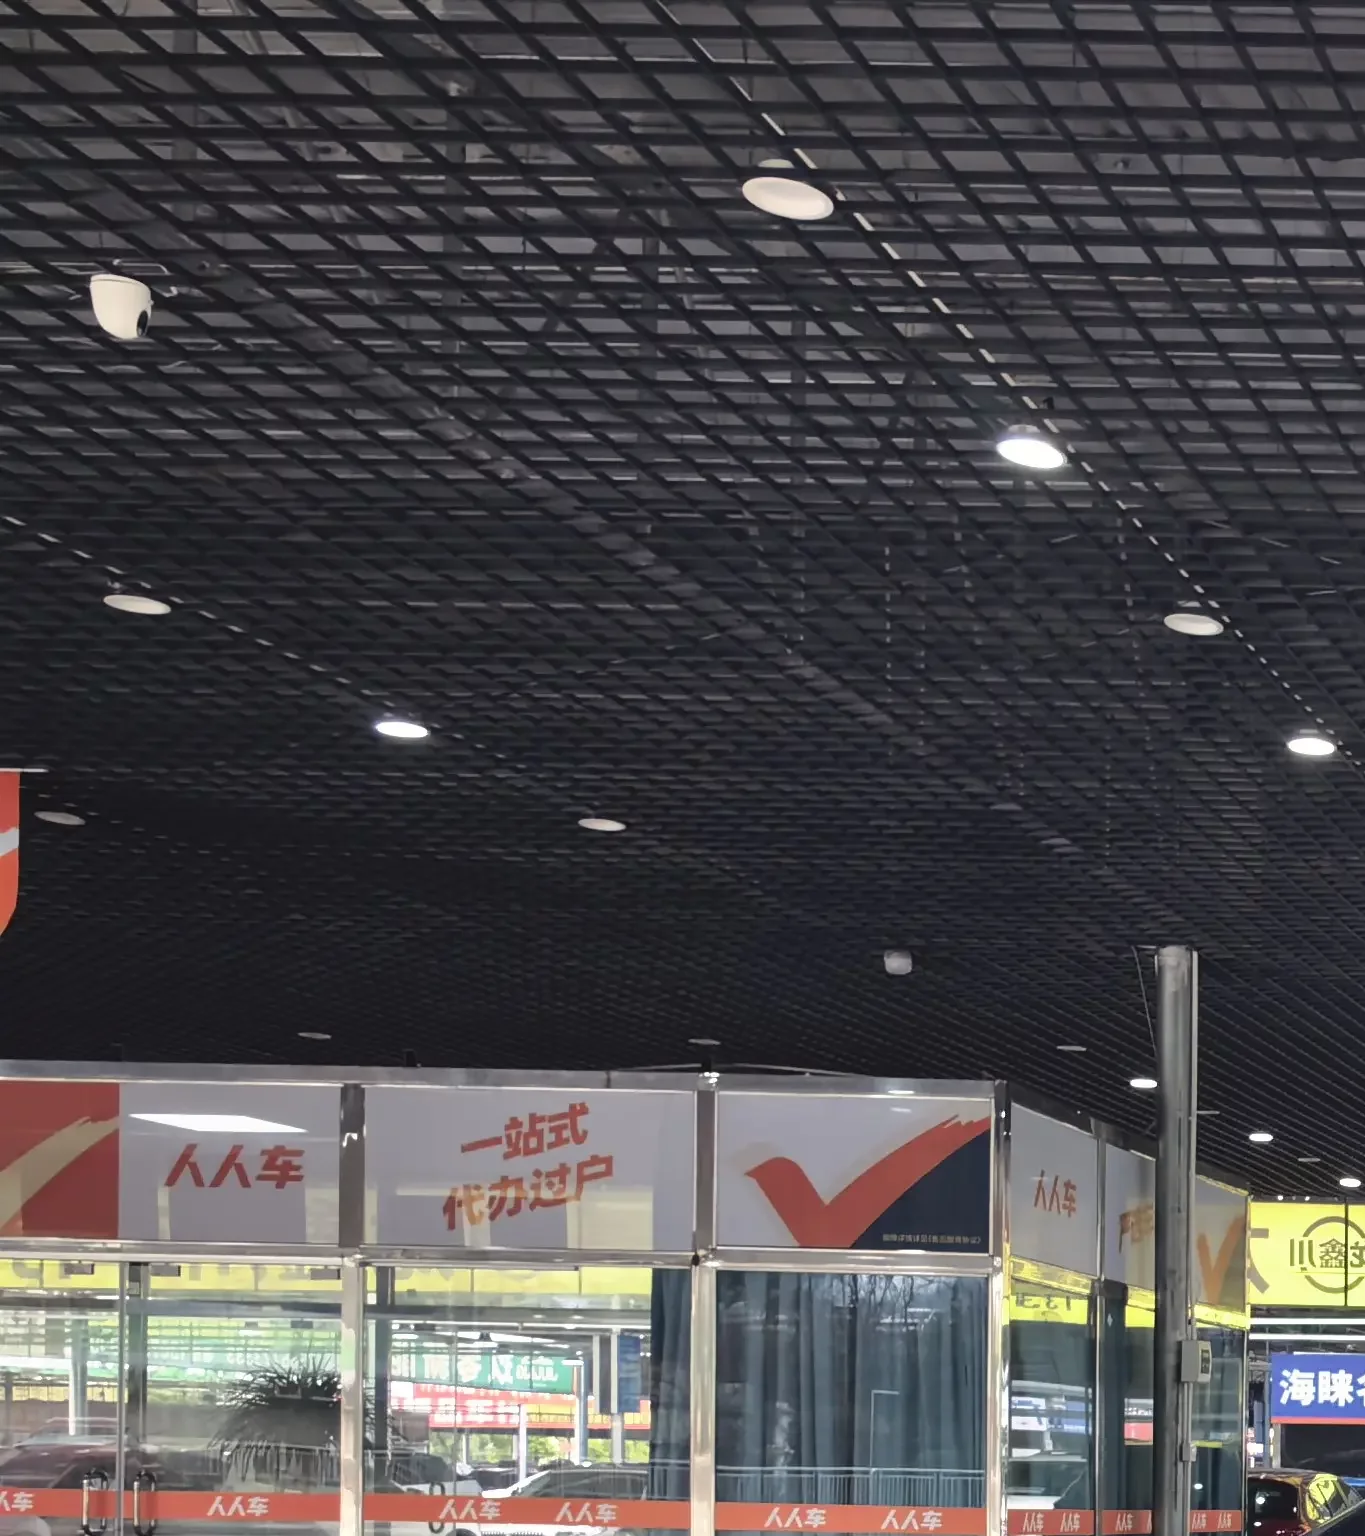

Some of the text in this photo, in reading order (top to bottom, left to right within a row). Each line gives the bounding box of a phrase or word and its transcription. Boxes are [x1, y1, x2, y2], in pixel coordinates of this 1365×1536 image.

[461, 1102, 590, 1160] 一站式
[164, 1143, 304, 1189] 人人车
[442, 1155, 614, 1231] 代办过户
[1034, 1170, 1077, 1217] 人人车
[207, 1496, 269, 1516] 人人车
[439, 1500, 501, 1520] 人人车
[555, 1502, 617, 1523] 人人车
[764, 1507, 826, 1529] 人人车
[881, 1509, 943, 1531] 人人车
[1022, 1512, 1044, 1532] 人人车
[1060, 1511, 1081, 1531] 人人车
